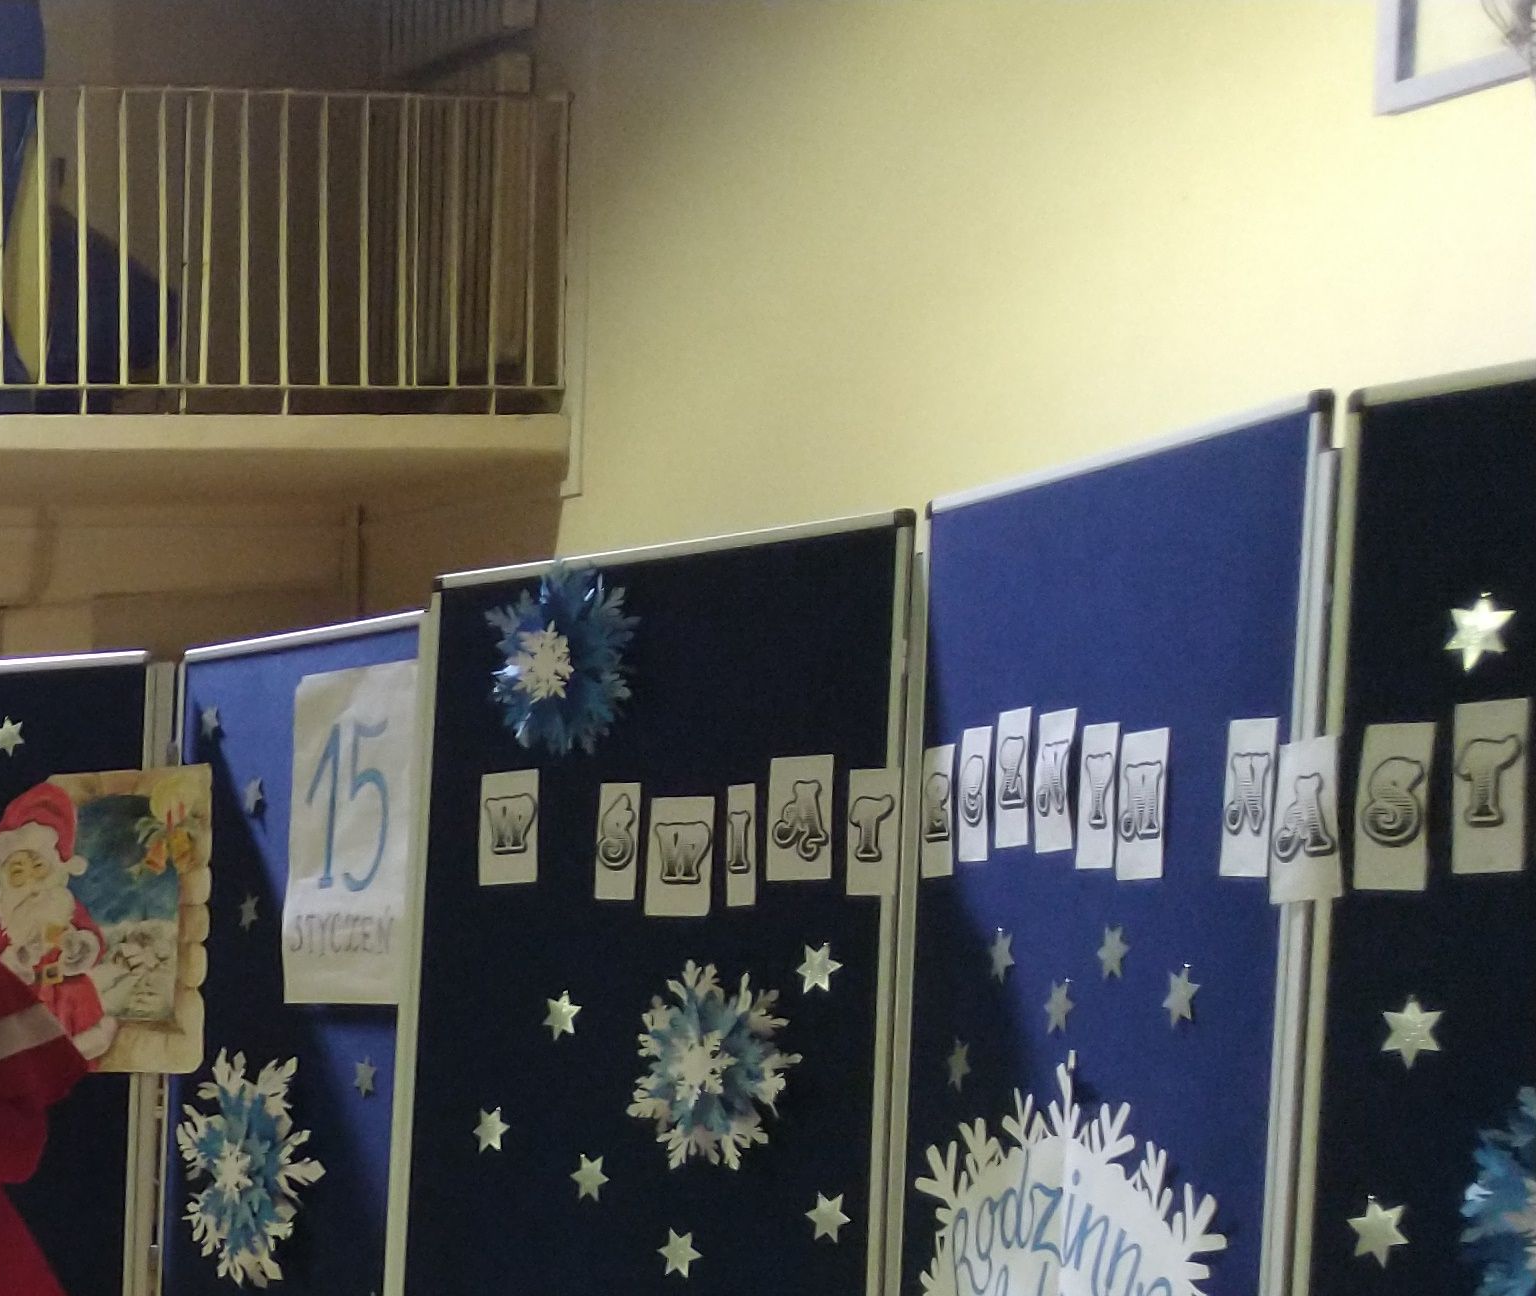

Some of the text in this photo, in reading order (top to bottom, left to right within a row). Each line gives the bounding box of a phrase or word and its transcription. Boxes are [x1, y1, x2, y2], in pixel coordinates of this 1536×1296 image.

[307, 718, 389, 892] 15
[484, 792, 538, 855] W
[1223, 732, 1524, 864] NAST
